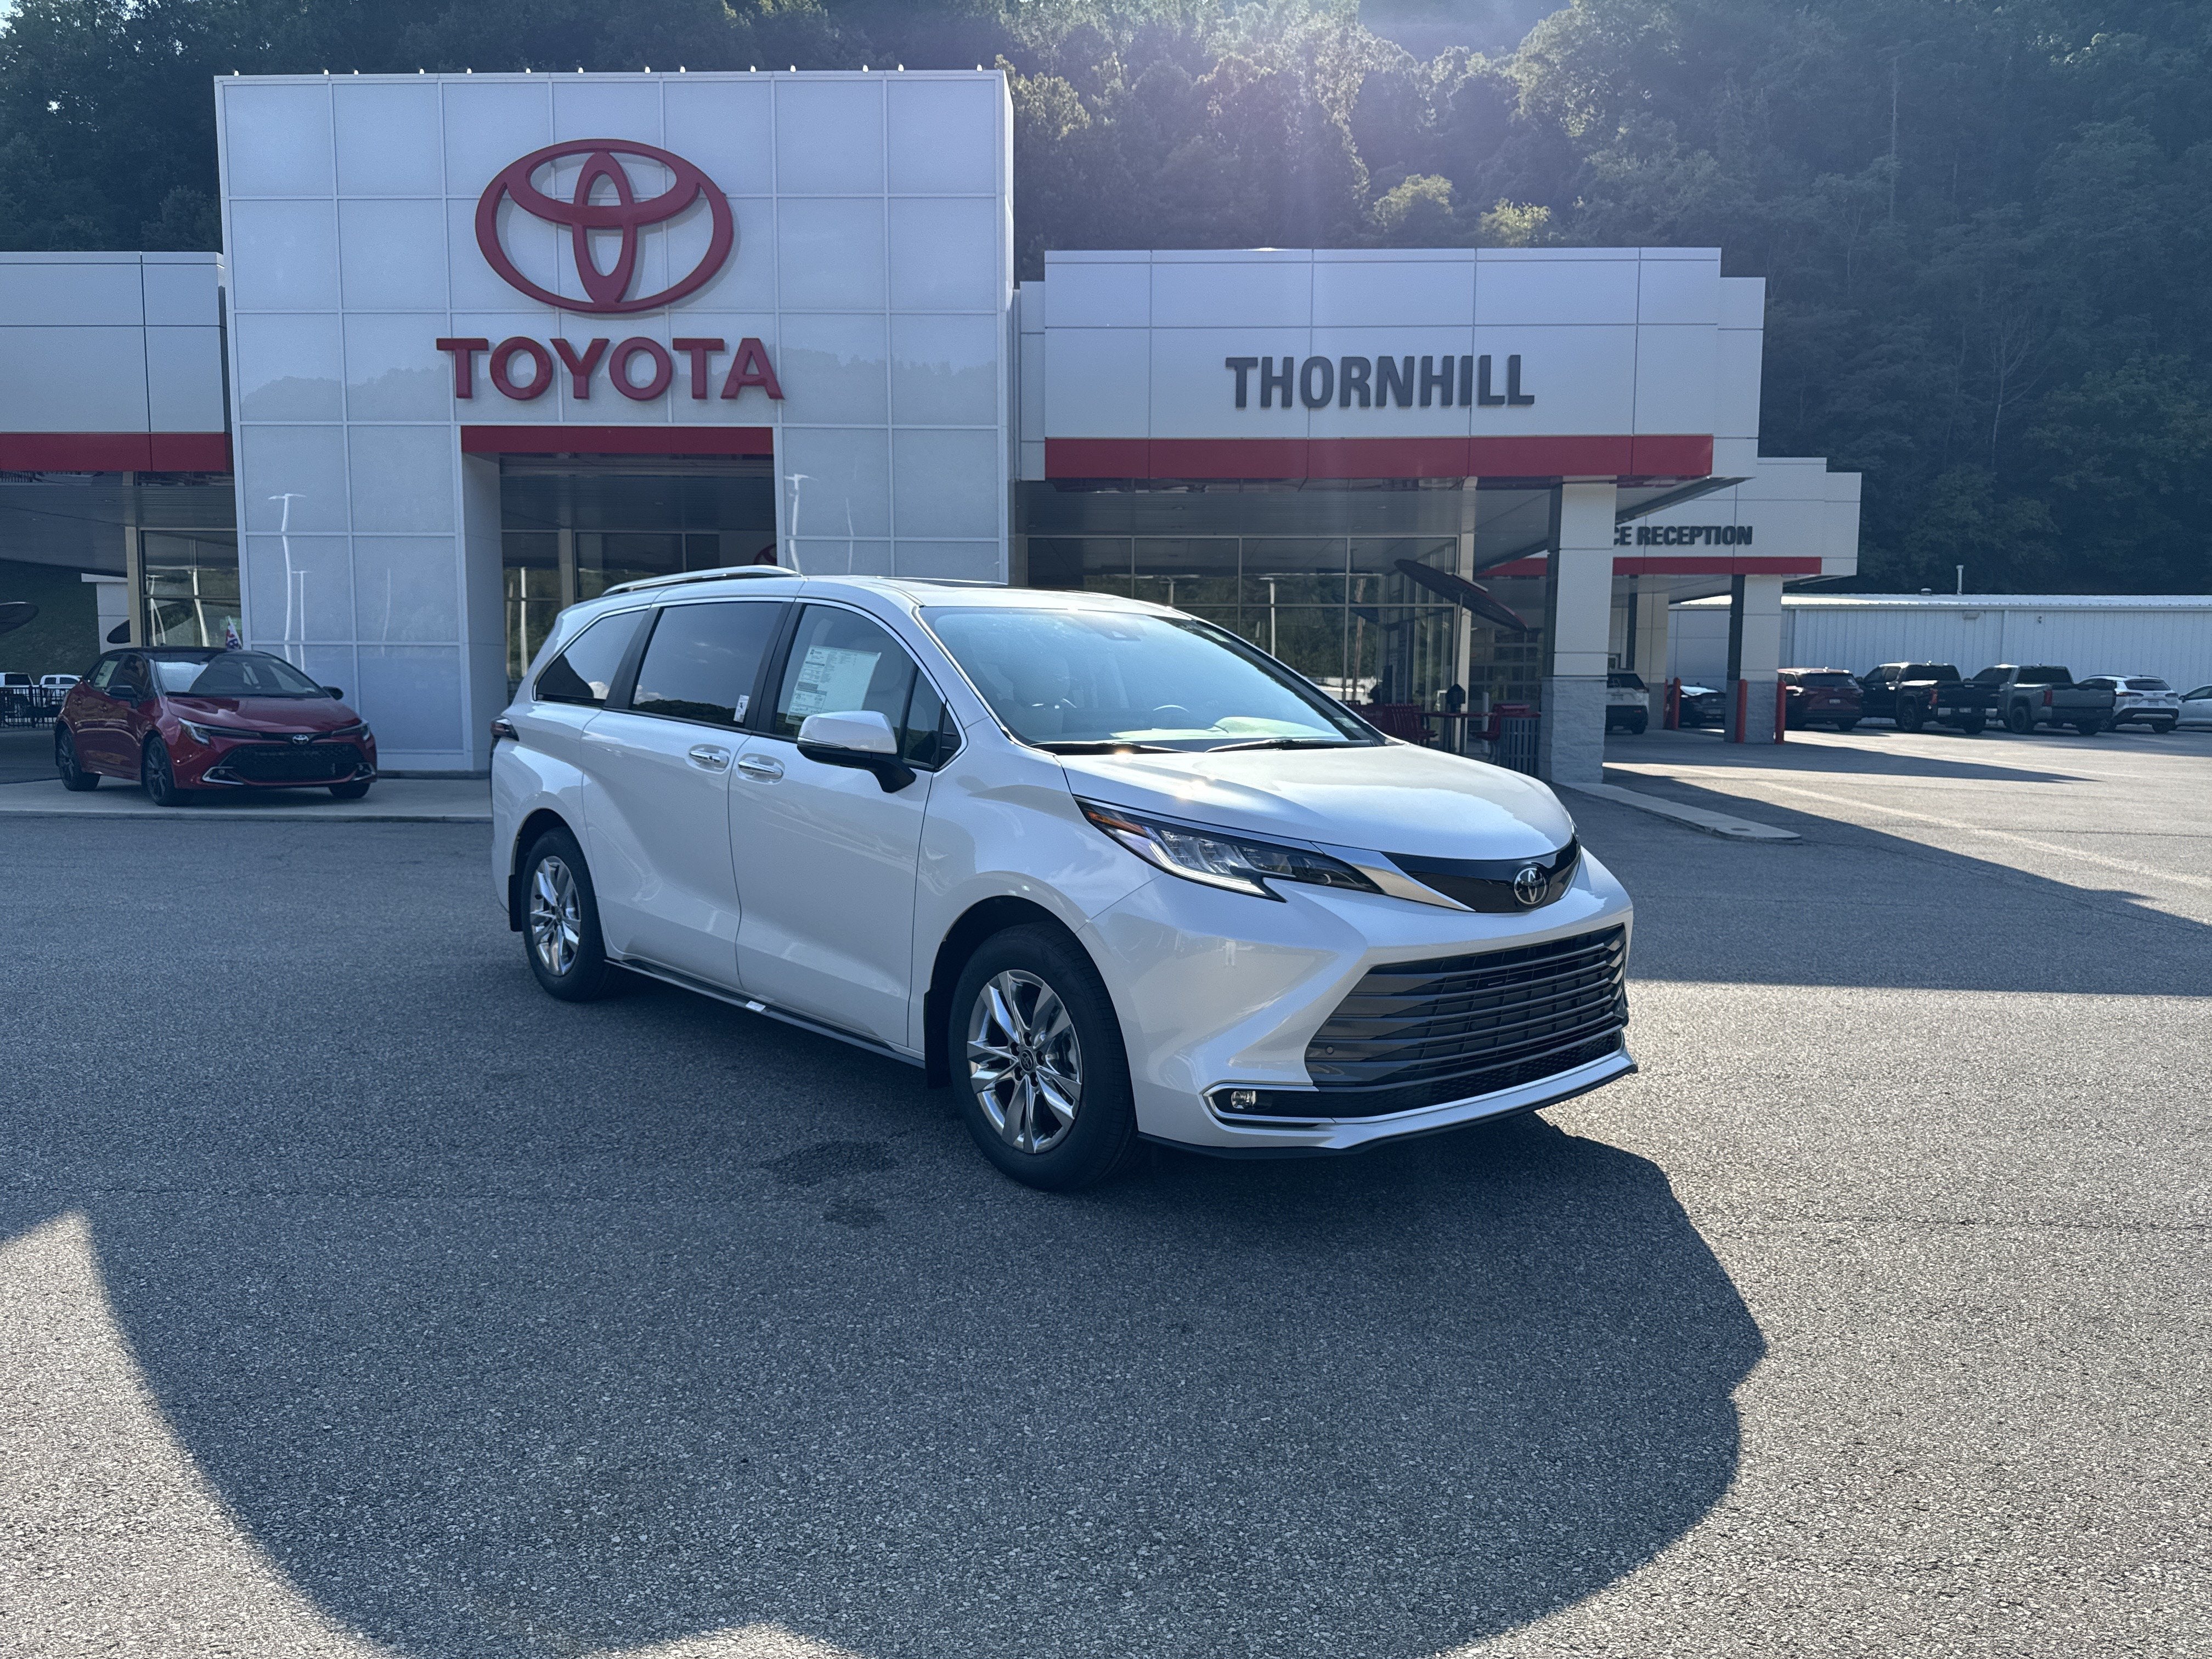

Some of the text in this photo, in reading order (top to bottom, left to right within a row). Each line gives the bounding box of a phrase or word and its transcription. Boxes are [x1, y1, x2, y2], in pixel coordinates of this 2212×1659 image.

[436, 336, 785, 401] TOYOTA
[1225, 354, 1535, 409] THORNHILL
[1637, 526, 1753, 545] RECEPTION
